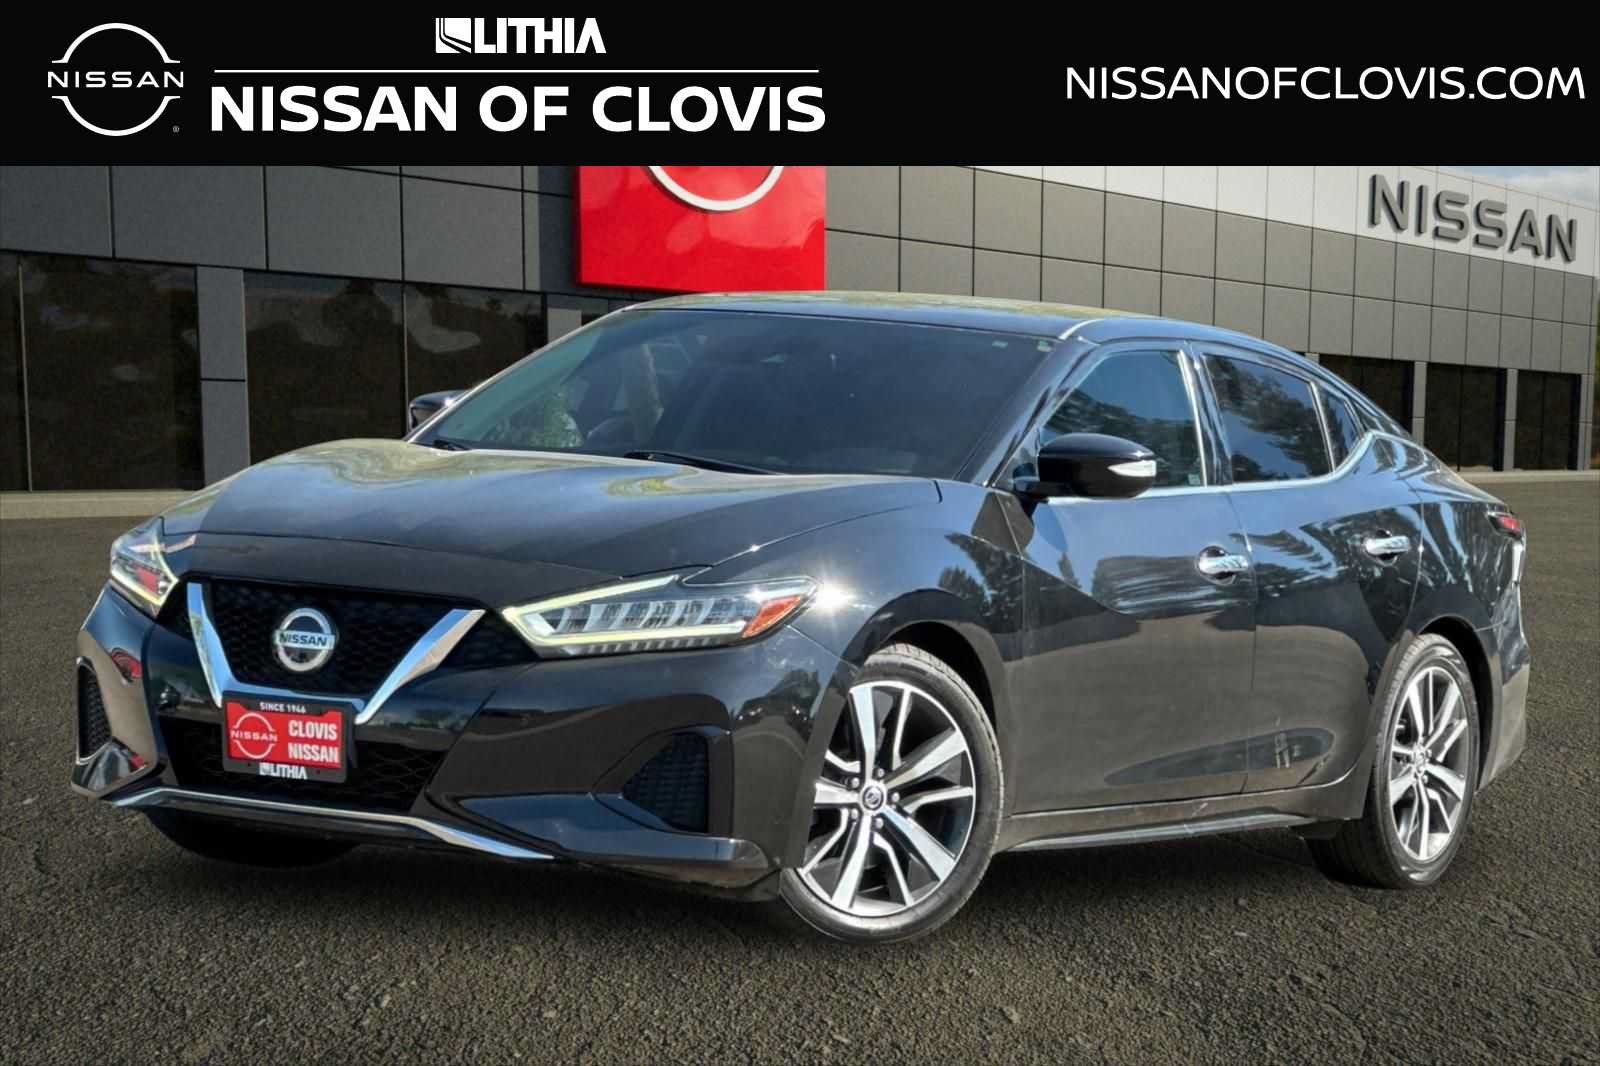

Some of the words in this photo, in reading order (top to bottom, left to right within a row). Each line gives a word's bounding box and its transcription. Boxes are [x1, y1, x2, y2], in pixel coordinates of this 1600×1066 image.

[1368, 173, 1577, 263] NISSAN
[279, 632, 328, 647] NISSAN
[260, 702, 285, 712] SINCE
[230, 730, 278, 742] NISSAN
[288, 719, 338, 740] CLOVIS
[288, 742, 339, 763] NISSAN
[270, 763, 308, 780] LITHIA
